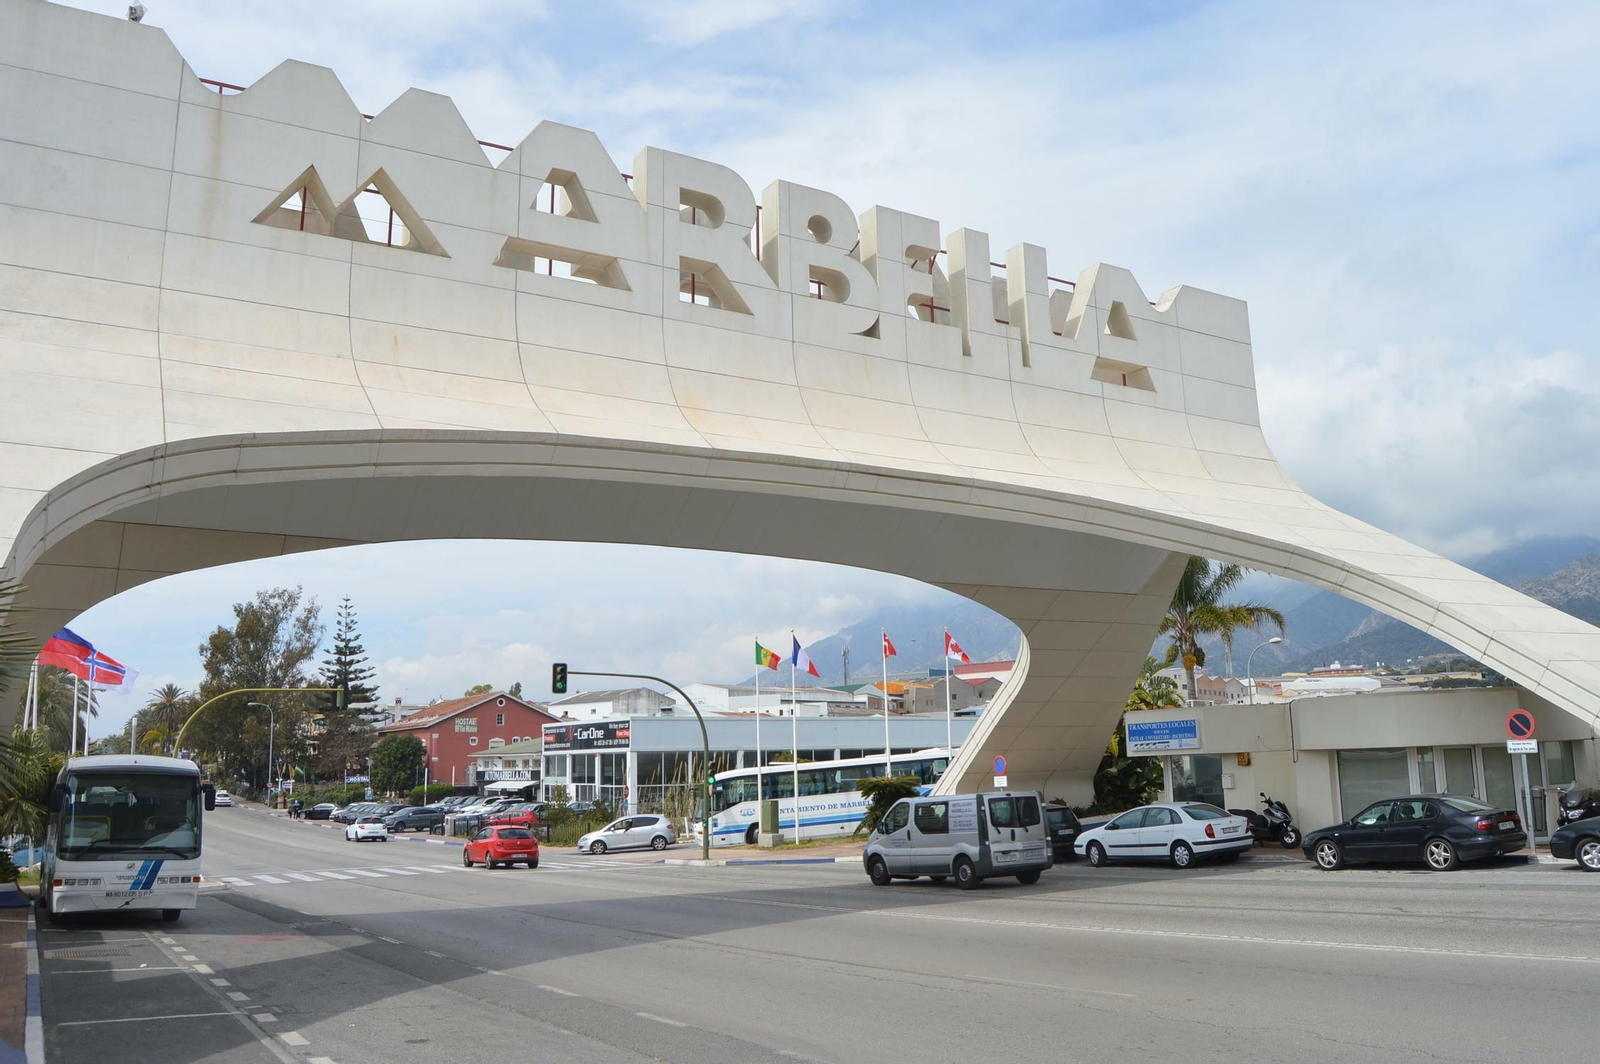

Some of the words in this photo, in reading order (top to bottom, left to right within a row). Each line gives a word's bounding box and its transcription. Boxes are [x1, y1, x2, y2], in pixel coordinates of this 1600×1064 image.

[250, 58, 1172, 396] MARBELLA
[455, 717, 476, 725] HOSTAL
[1129, 723, 1168, 731] TRANSPORTES
[1168, 720, 1195, 728] LOCALES
[484, 770, 532, 781] AUTOMARBELLA.COM
[779, 804, 826, 814] NTAMIENTO
[840, 800, 874, 809] MARBEL
